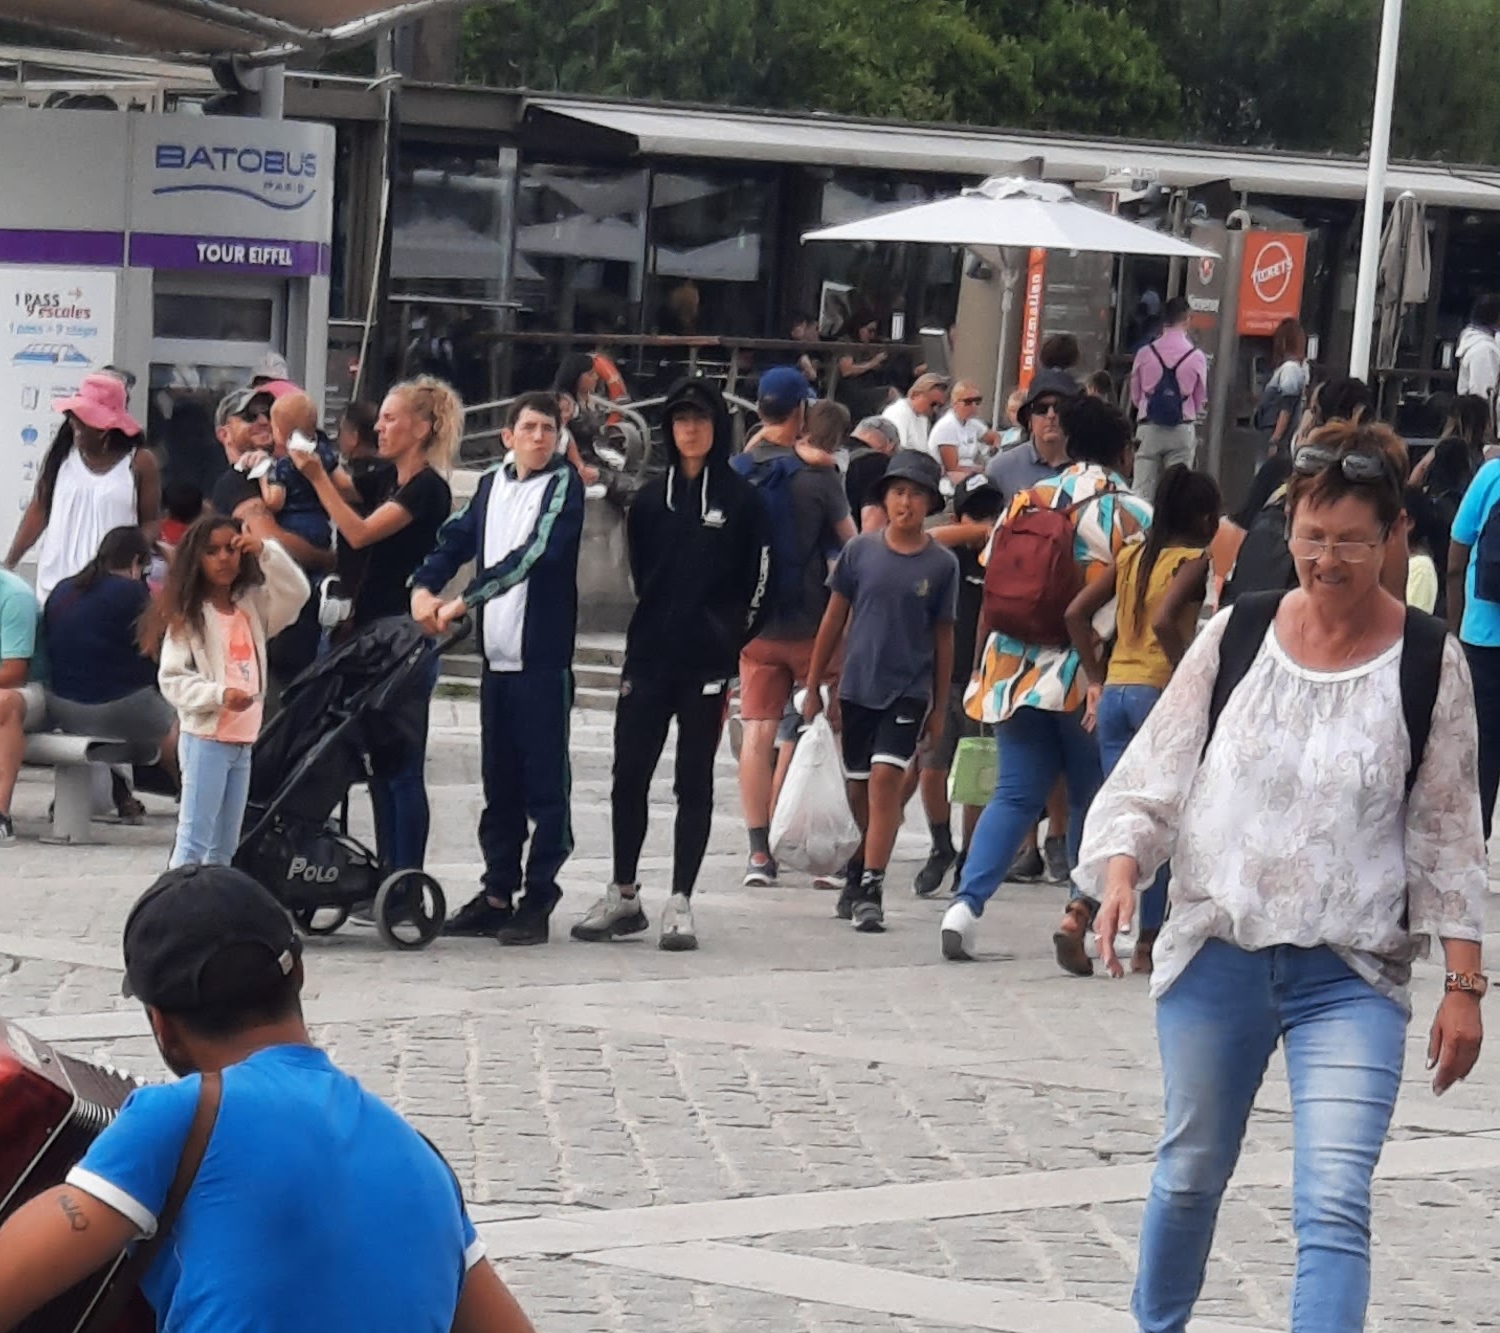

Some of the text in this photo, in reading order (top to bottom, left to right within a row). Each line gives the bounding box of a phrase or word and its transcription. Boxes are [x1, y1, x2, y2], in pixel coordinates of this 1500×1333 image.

[155, 144, 317, 178] BATOBUS
[197, 243, 293, 266] TOUR EIFFEL
[24, 292, 60, 307] PASS
[38, 304, 92, 319] escales
